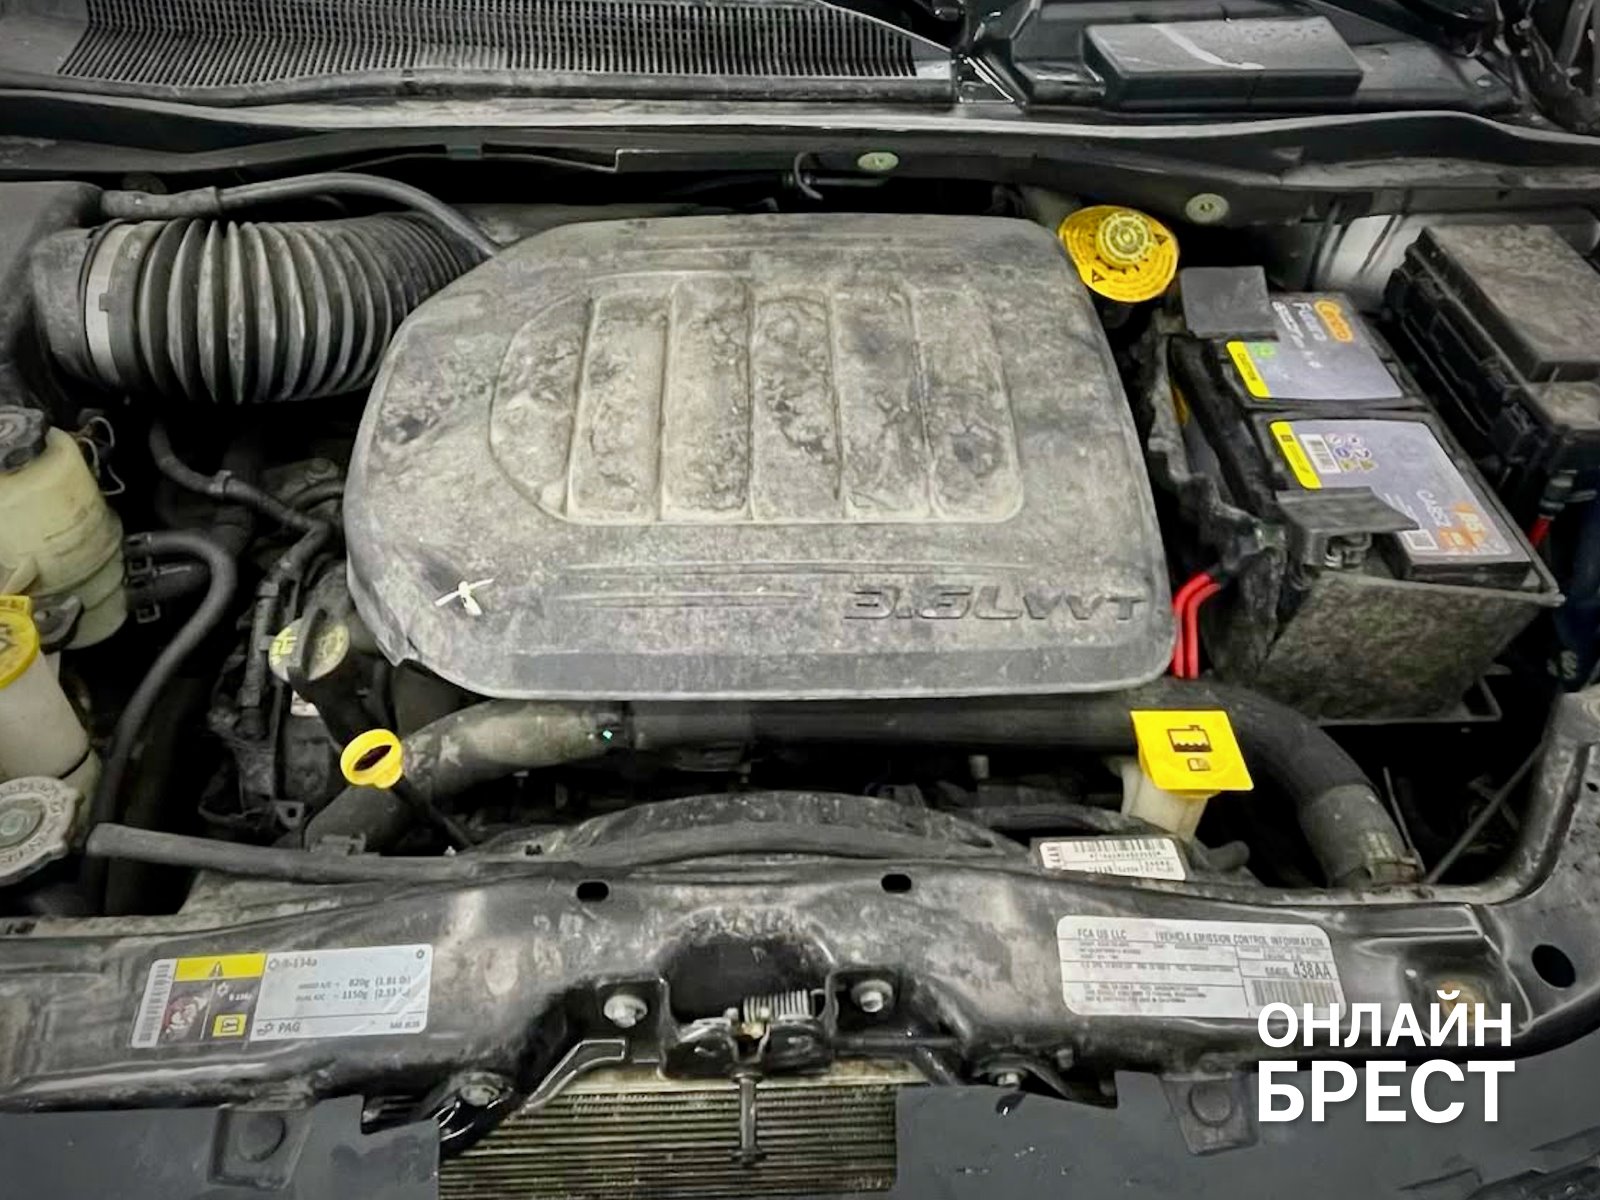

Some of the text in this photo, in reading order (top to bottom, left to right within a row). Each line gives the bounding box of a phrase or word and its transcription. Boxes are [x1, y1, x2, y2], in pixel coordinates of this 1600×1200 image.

[1077, 927, 1095, 939] FCA
[1110, 928, 1128, 941] LLC
[1193, 932, 1232, 945] EMISSION
[1232, 933, 1268, 946] CONTROL
[1269, 935, 1326, 947] INFORMATION
[1292, 961, 1333, 979] 438AA
[277, 1021, 301, 1033] PAG
